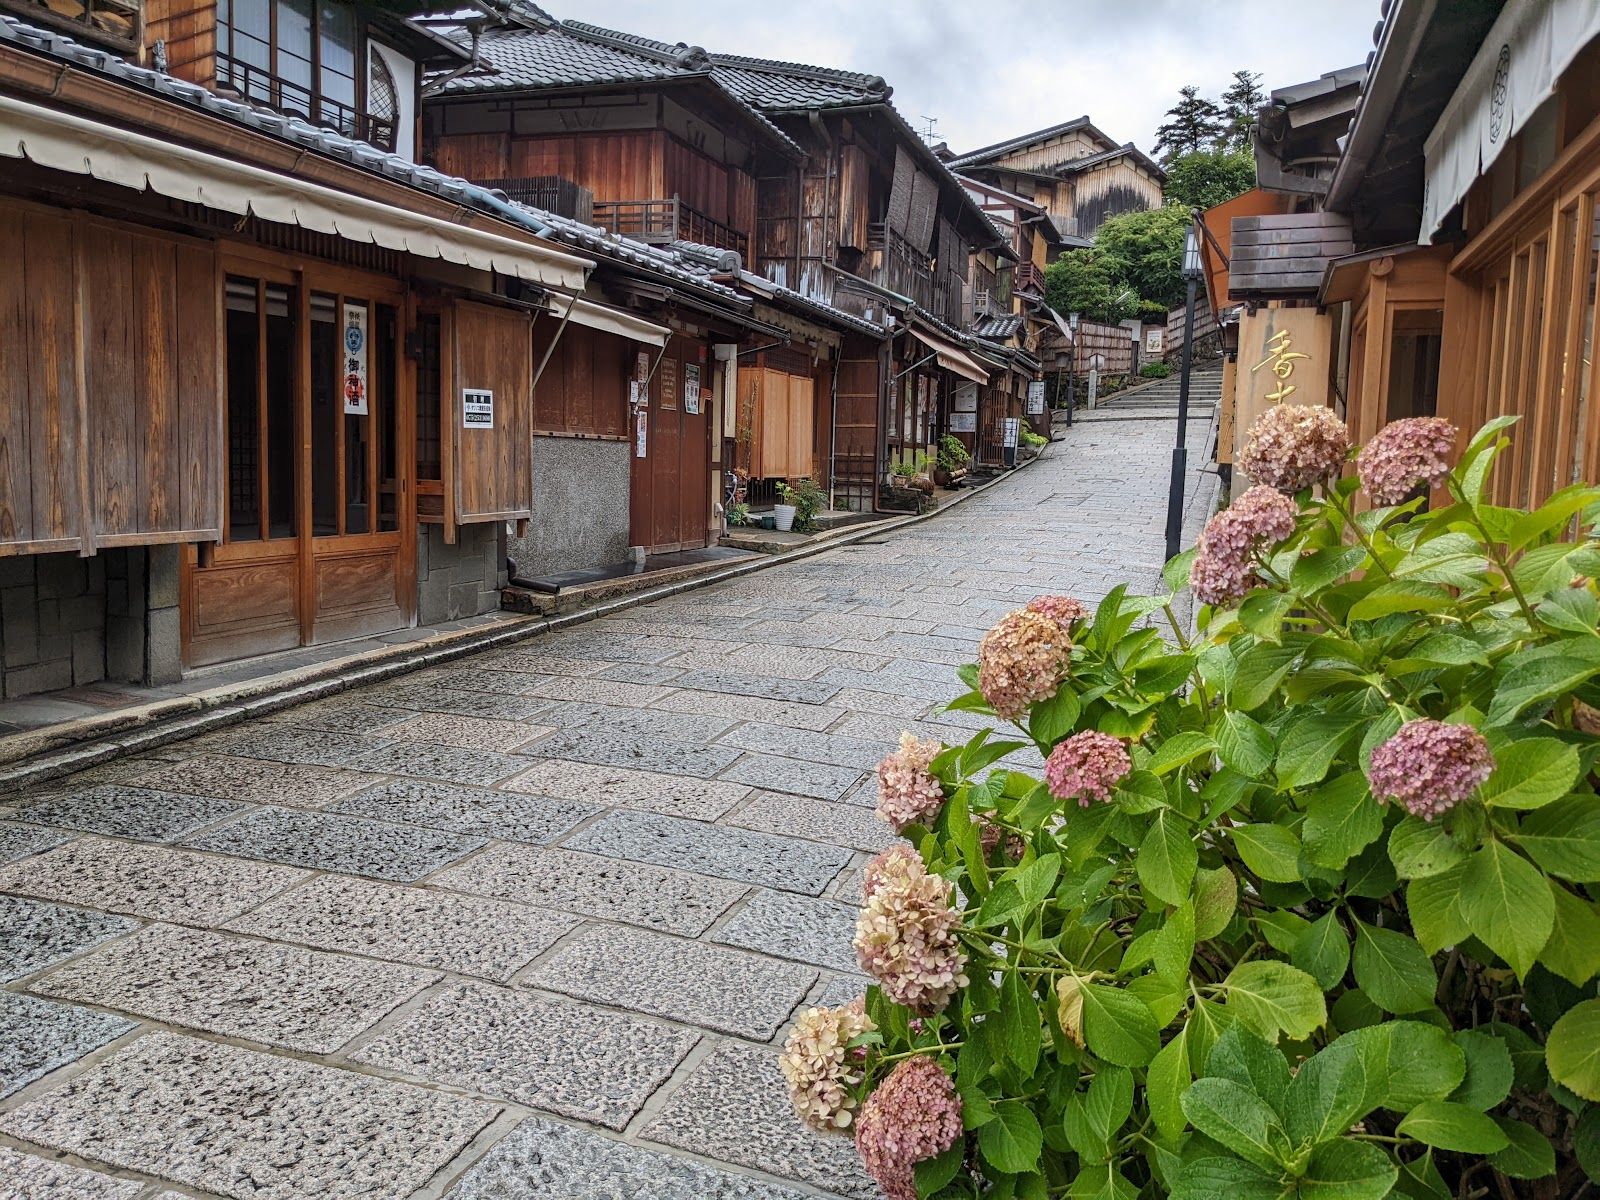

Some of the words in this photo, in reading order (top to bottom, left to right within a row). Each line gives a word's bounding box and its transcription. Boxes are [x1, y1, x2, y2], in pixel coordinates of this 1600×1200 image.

[348, 357, 360, 406] 御神酒
[1251, 329, 1312, 404] 香十
